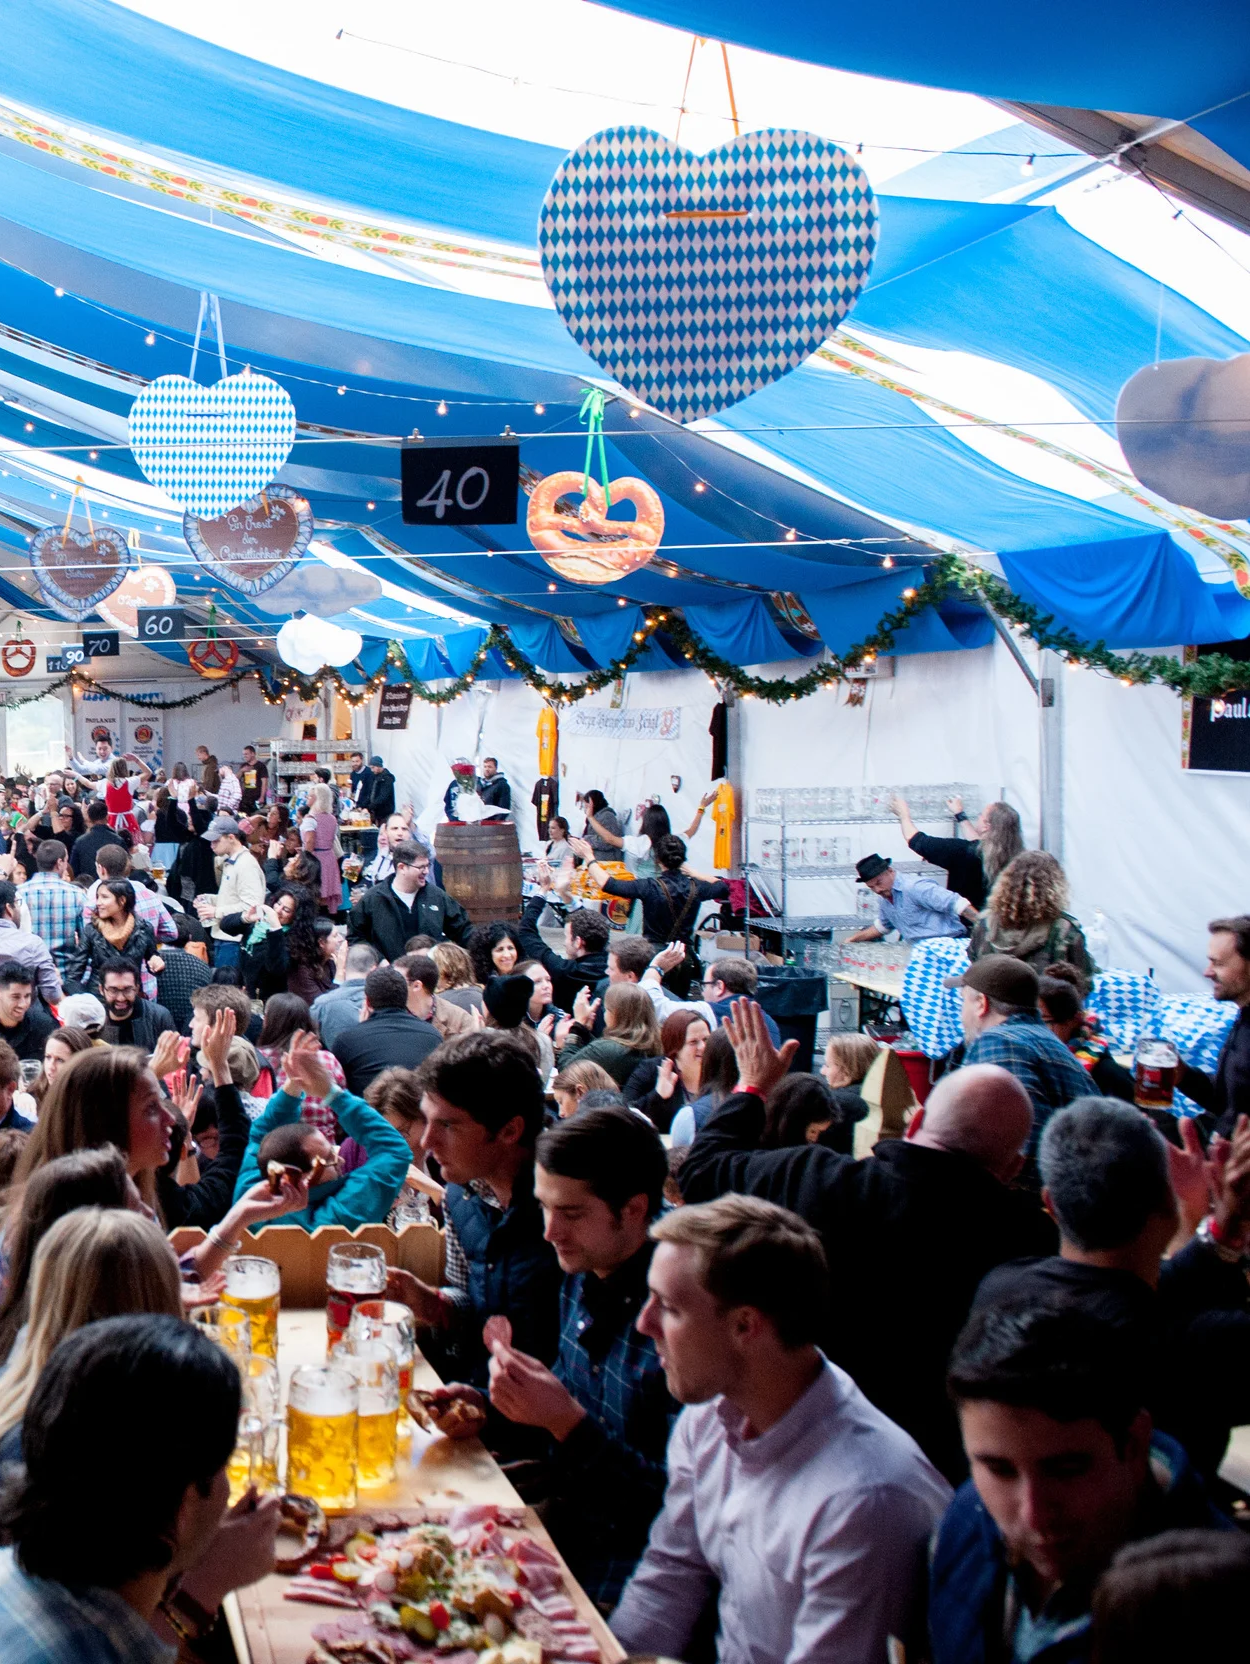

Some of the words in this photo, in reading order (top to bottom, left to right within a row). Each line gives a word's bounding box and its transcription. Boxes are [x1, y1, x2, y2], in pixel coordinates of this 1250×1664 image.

[415, 466, 490, 519] 40
[144, 615, 173, 635] 60
[65, 650, 85, 664] 90
[88, 639, 111, 656] 70
[1209, 696, 1250, 722] Paul
